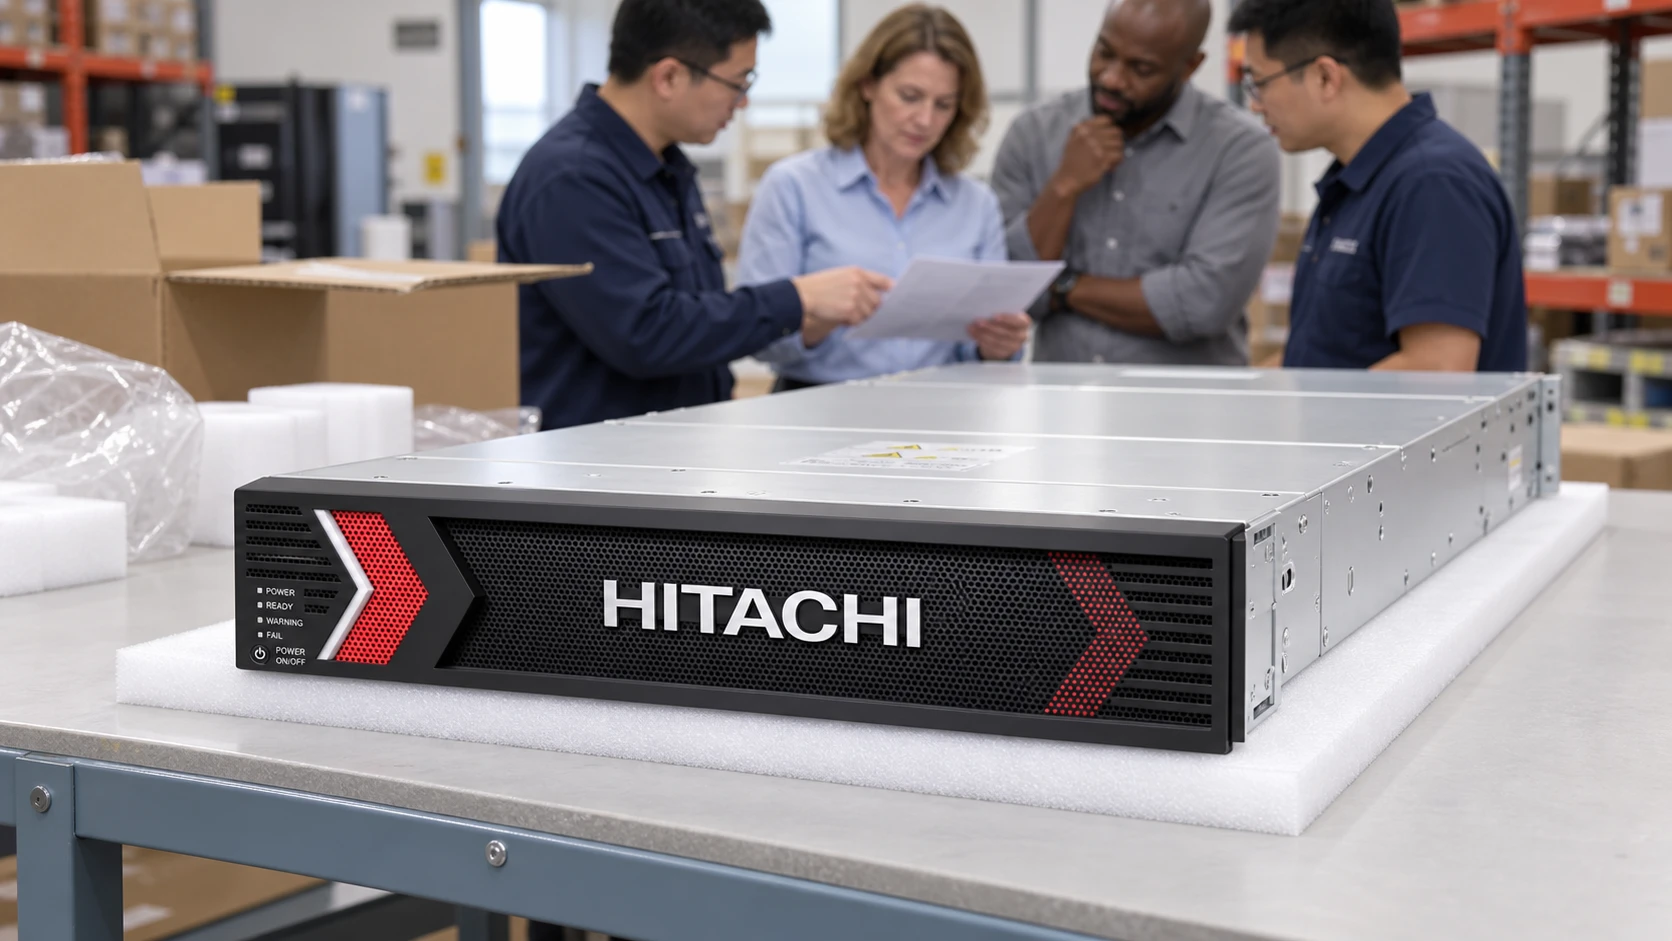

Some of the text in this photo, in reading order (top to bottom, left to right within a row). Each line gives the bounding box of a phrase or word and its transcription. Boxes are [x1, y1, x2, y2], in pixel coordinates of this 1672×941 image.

[266, 587, 295, 597] POWER
[266, 601, 294, 610] READY
[603, 579, 921, 648] HITACHI
[266, 617, 304, 627] WARNING
[266, 631, 283, 639] FAIL
[275, 646, 306, 656] POWER
[275, 657, 306, 666] ON/OFF
